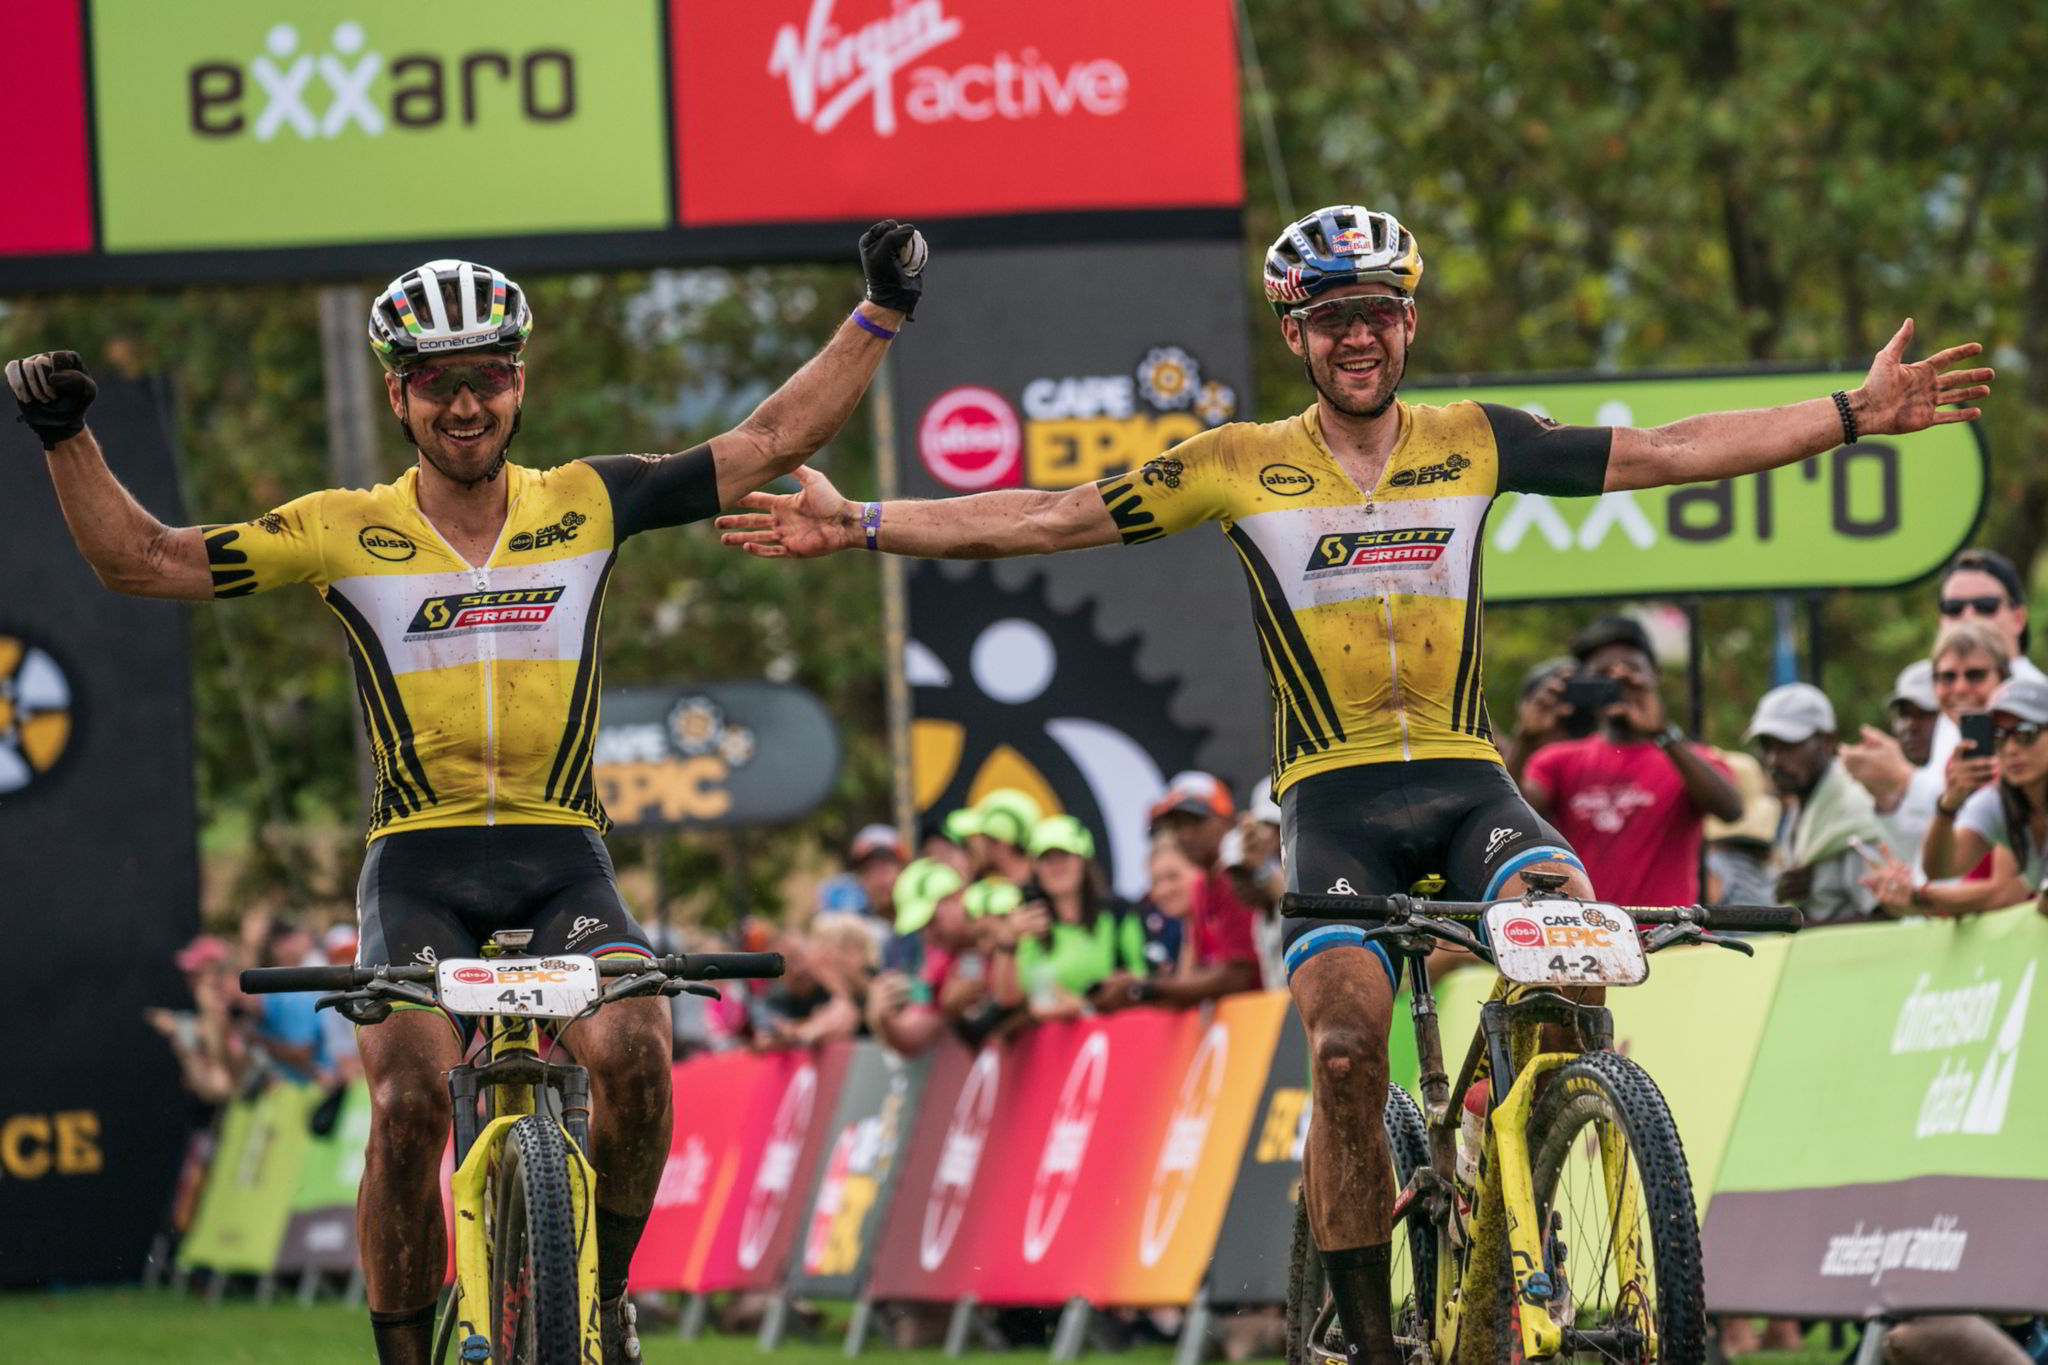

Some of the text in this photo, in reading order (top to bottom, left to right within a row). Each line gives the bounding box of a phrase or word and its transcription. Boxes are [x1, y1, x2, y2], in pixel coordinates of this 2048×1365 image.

[768, 0, 962, 138] Virgin
[189, 22, 577, 140] exxaro
[905, 48, 1129, 122] active
[419, 329, 498, 350] cornercard
[1023, 374, 1135, 419] CAPE
[1416, 467, 1461, 486] EPIC
[1419, 463, 1445, 473] CAPE
[1266, 472, 1308, 485] absa
[535, 522, 561, 535] CAPE
[535, 525, 578, 549] EPIC
[366, 535, 408, 549] absa
[1355, 530, 1450, 546] SCOTT
[1362, 549, 1437, 562] SRAM
[458, 589, 560, 607] SCOTT
[464, 609, 546, 623] SRAM
[595, 723, 668, 763] APE
[1542, 916, 1581, 926] CAPE
[1509, 926, 1614, 947] absa EPIC
[1548, 954, 1600, 974] 4-2
[459, 971, 568, 983] absa EPIC
[497, 989, 544, 1006] 4-1
